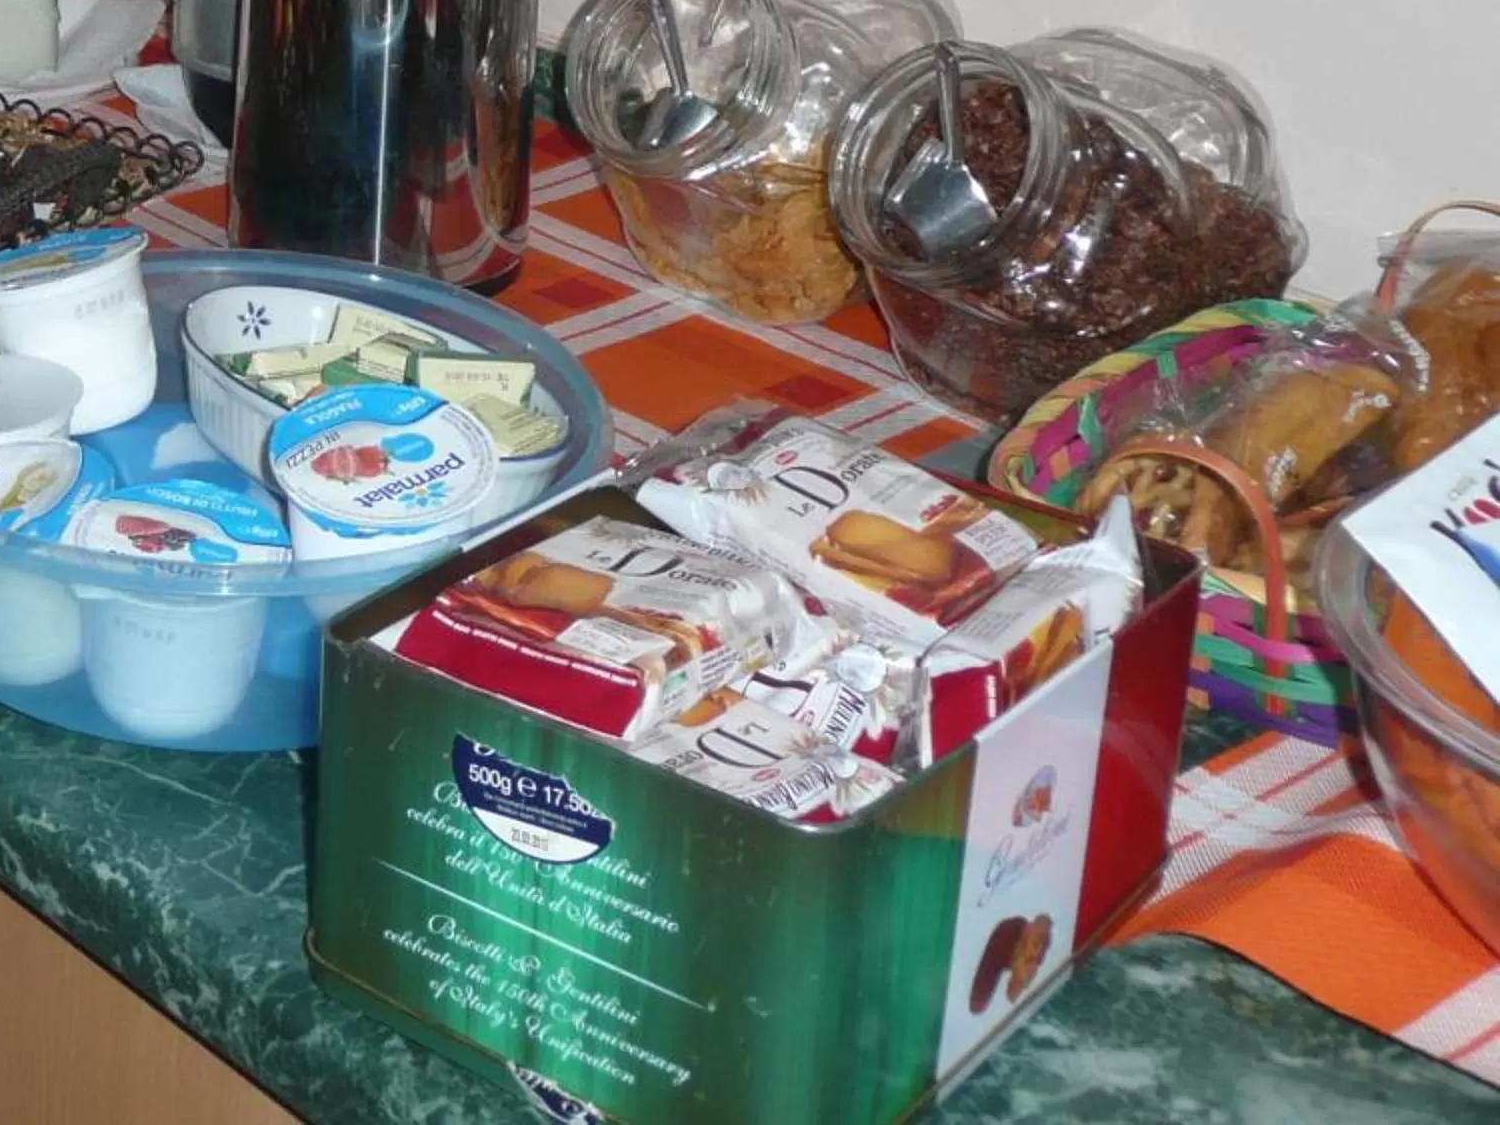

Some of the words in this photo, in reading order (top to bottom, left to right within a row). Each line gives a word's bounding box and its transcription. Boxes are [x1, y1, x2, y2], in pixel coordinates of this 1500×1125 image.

[353, 451, 466, 508] parmalat
[468, 763, 512, 796] 500g
[407, 807, 465, 840] celebra
[428, 914, 504, 962] Biscotti
[547, 966, 641, 1026] Gentilini
[383, 928, 461, 973] celebrates
[464, 963, 490, 986] the
[498, 980, 546, 1012] 150th
[551, 1002, 692, 1088] Anniversary
